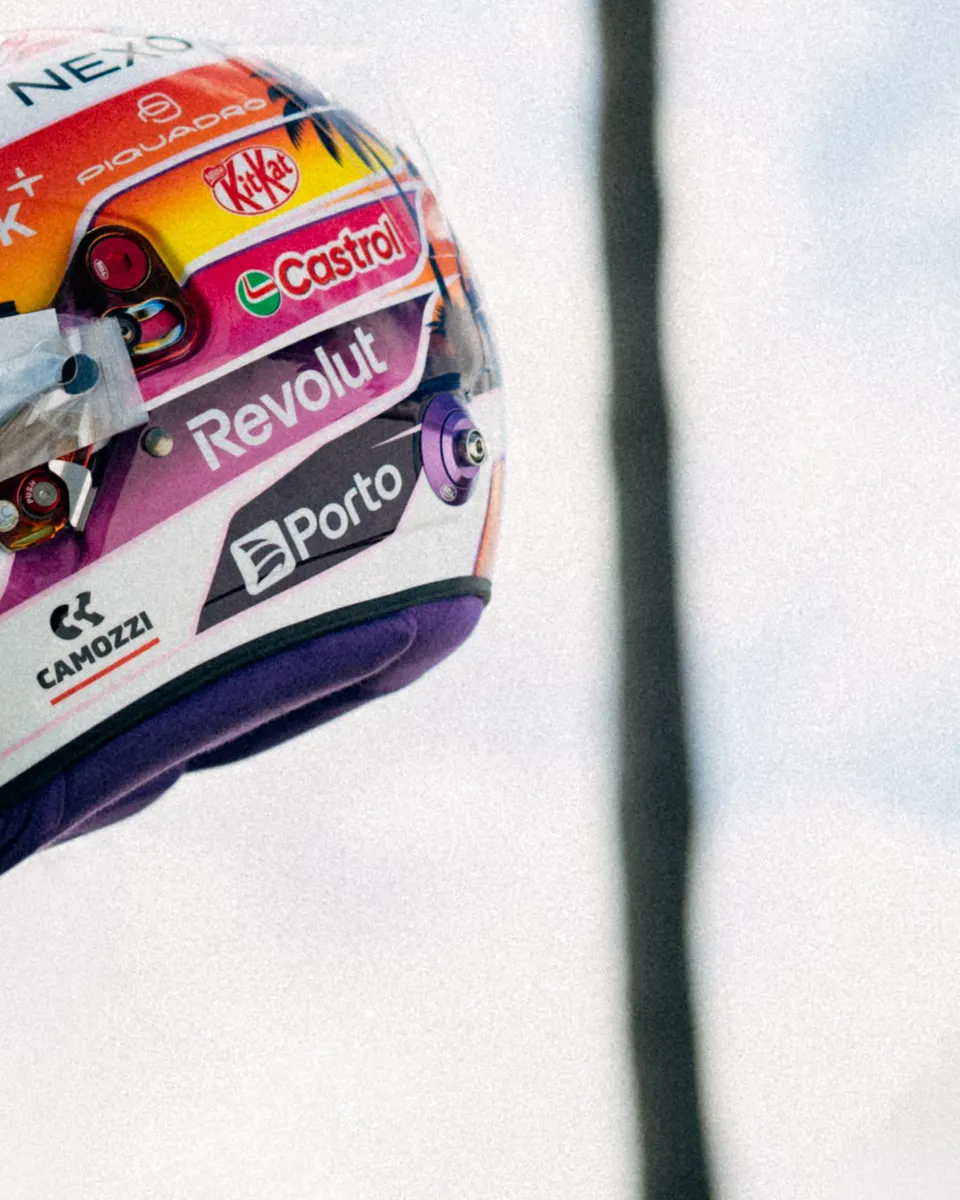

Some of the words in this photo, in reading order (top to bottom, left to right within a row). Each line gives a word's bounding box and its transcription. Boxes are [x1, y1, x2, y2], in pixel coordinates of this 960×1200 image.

[7, 35, 194, 107] NEXO
[75, 97, 268, 186] PIQUADRO
[220, 149, 294, 212] KitKat
[277, 219, 403, 296] Castrol
[185, 326, 388, 472] Revolut
[25, 479, 37, 505] PUSH
[283, 463, 403, 562] Porto
[36, 610, 154, 690] CAMOZZI
